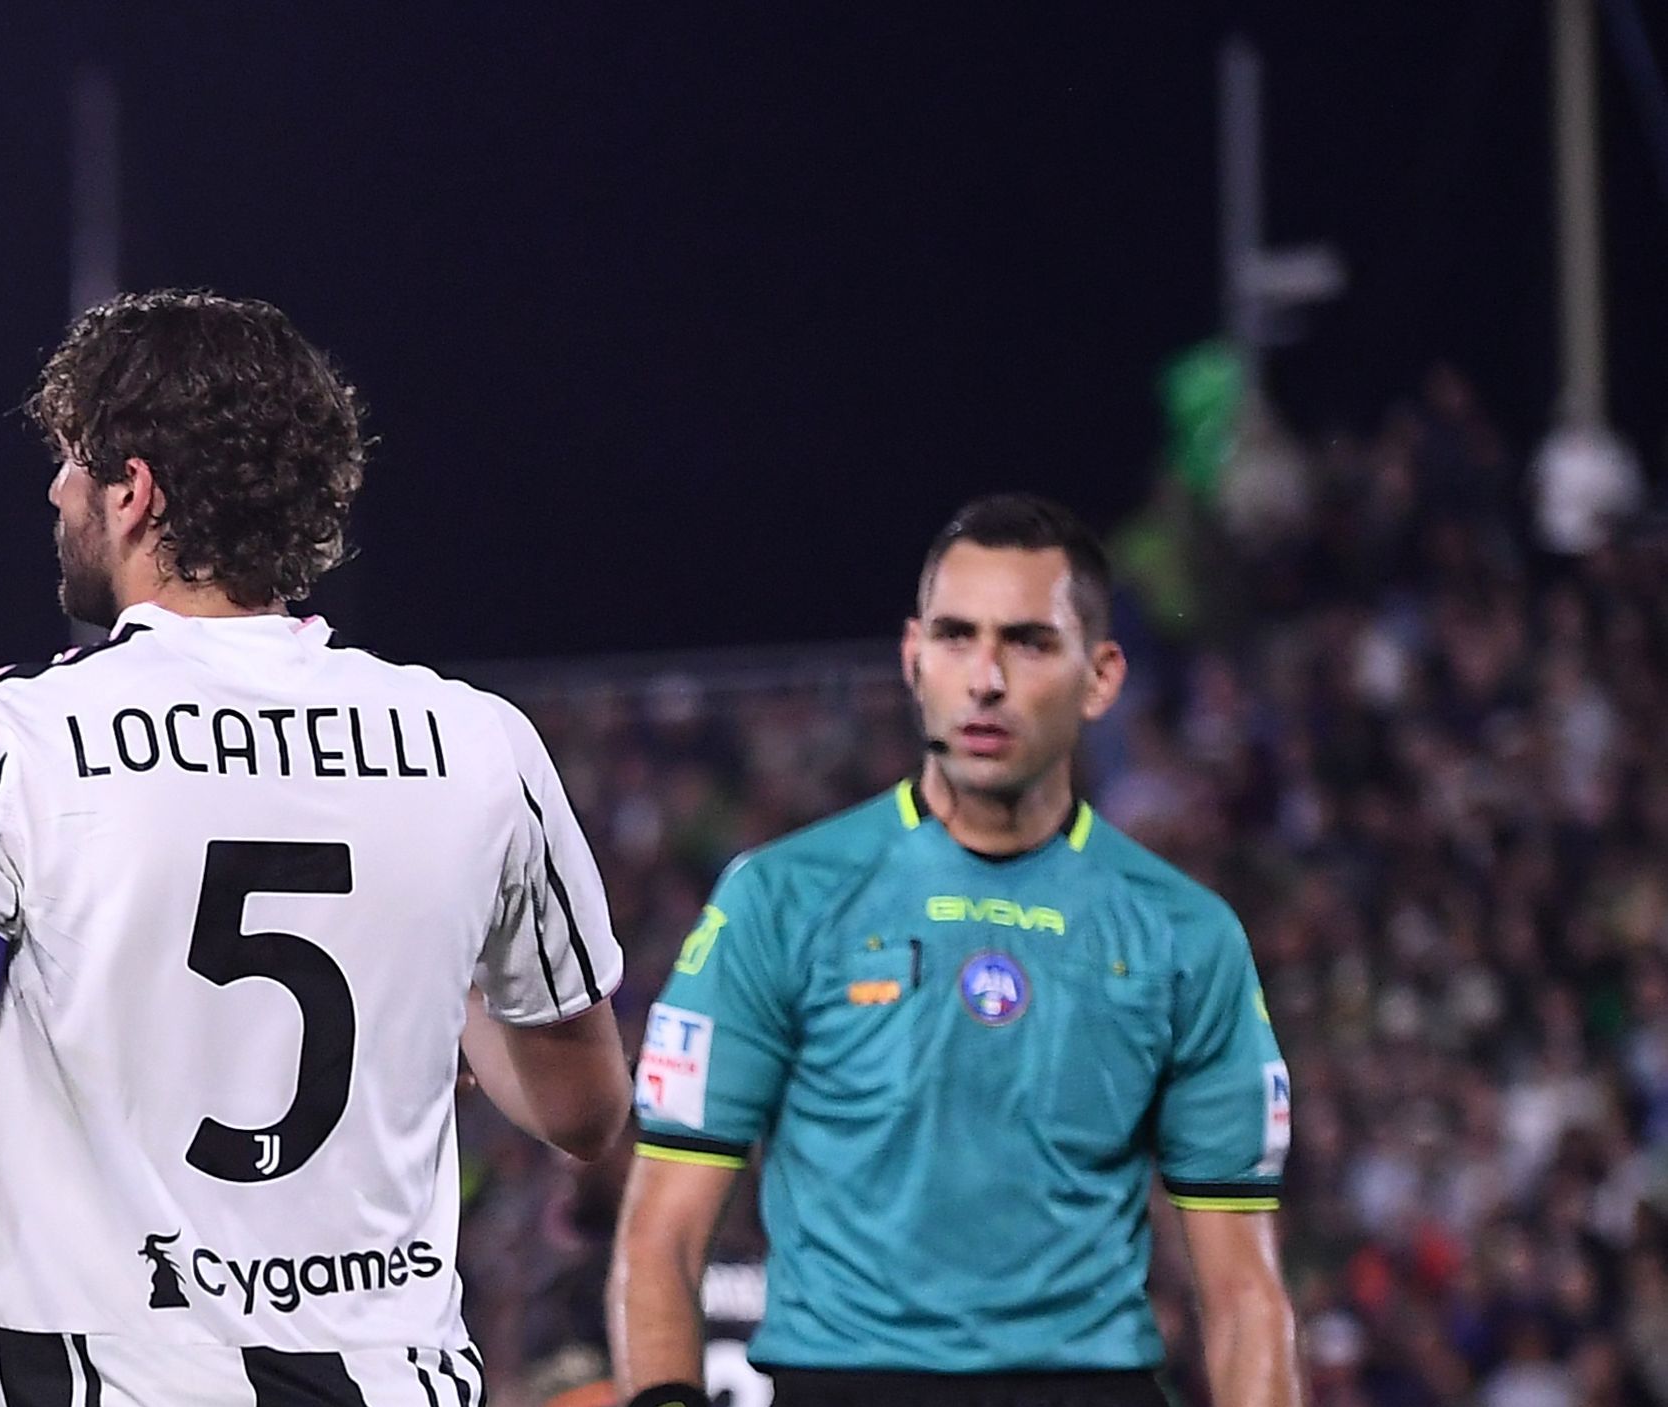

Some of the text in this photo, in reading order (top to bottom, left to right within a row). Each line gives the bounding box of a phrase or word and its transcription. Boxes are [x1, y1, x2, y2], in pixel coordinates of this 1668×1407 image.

[67, 703, 448, 779] LOCATELLI
[185, 838, 356, 1184] 5
[193, 1237, 443, 1314] Cygames
